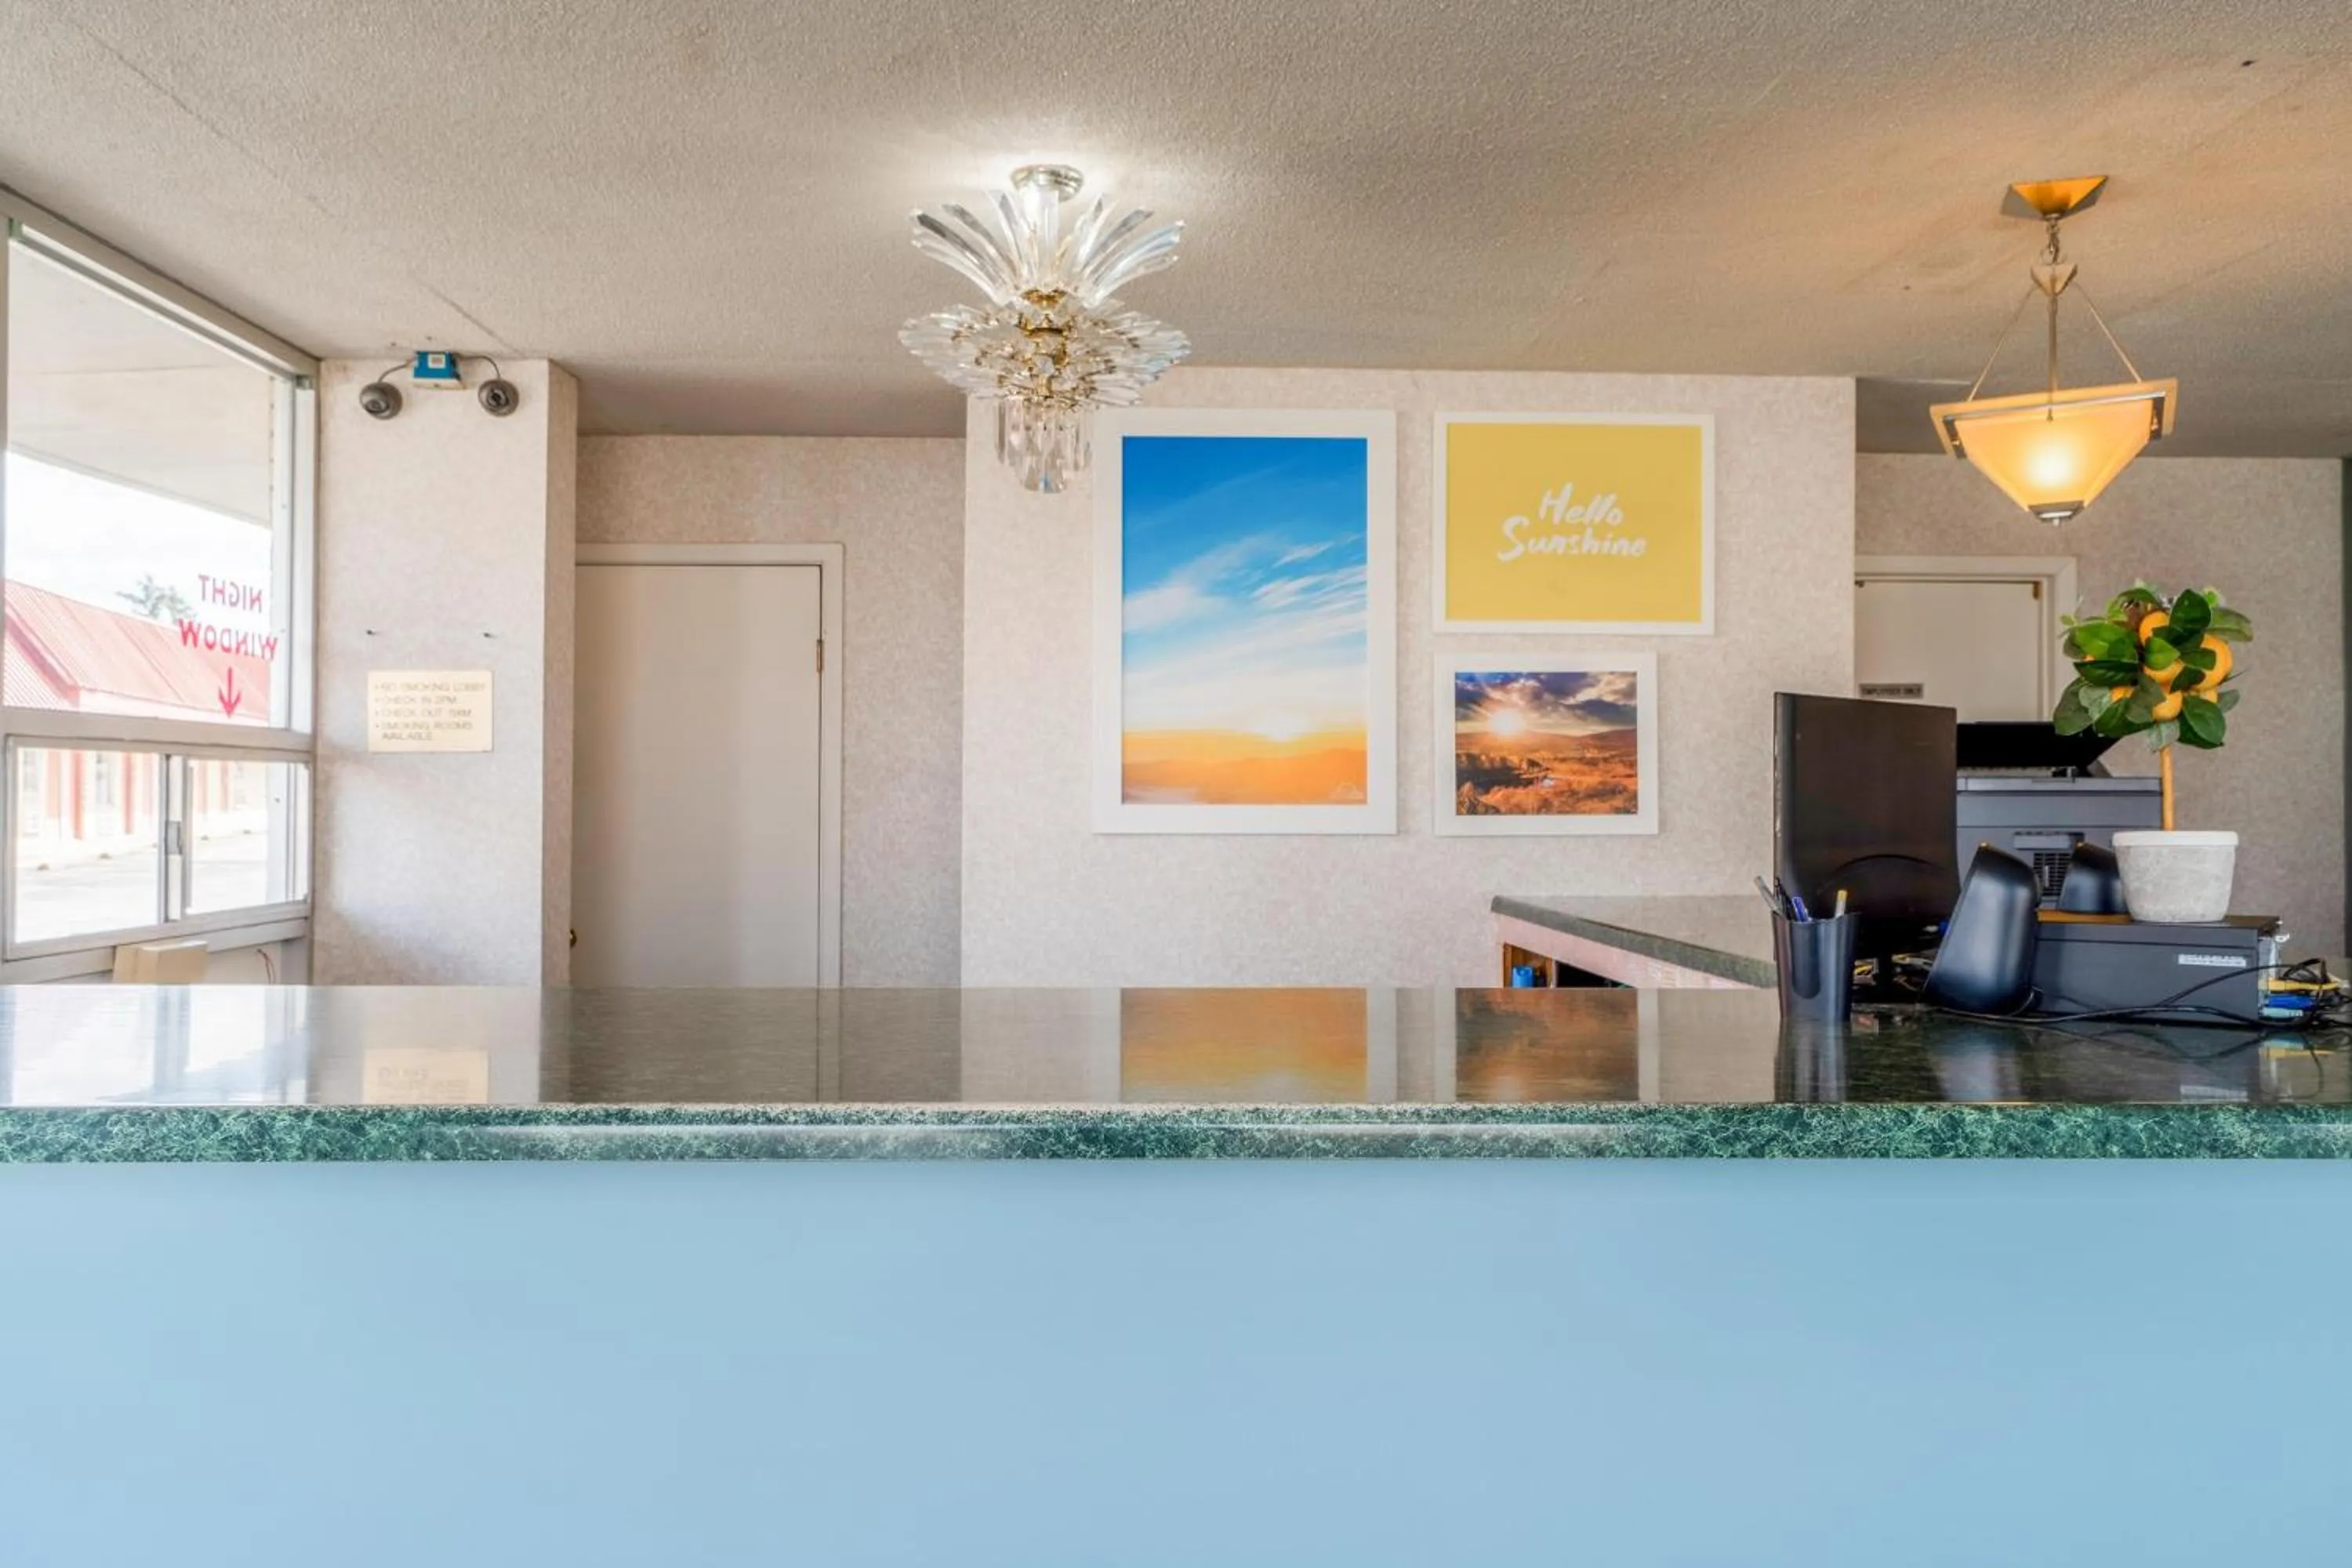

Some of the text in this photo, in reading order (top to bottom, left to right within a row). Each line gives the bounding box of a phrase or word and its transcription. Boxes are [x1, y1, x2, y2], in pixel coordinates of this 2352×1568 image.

[1537, 481, 1624, 526] Hello
[1497, 514, 1647, 563] Sunshine
[380, 695, 416, 704] CHECK
[380, 708, 416, 717] CHECK
[420, 708, 443, 717] OUT
